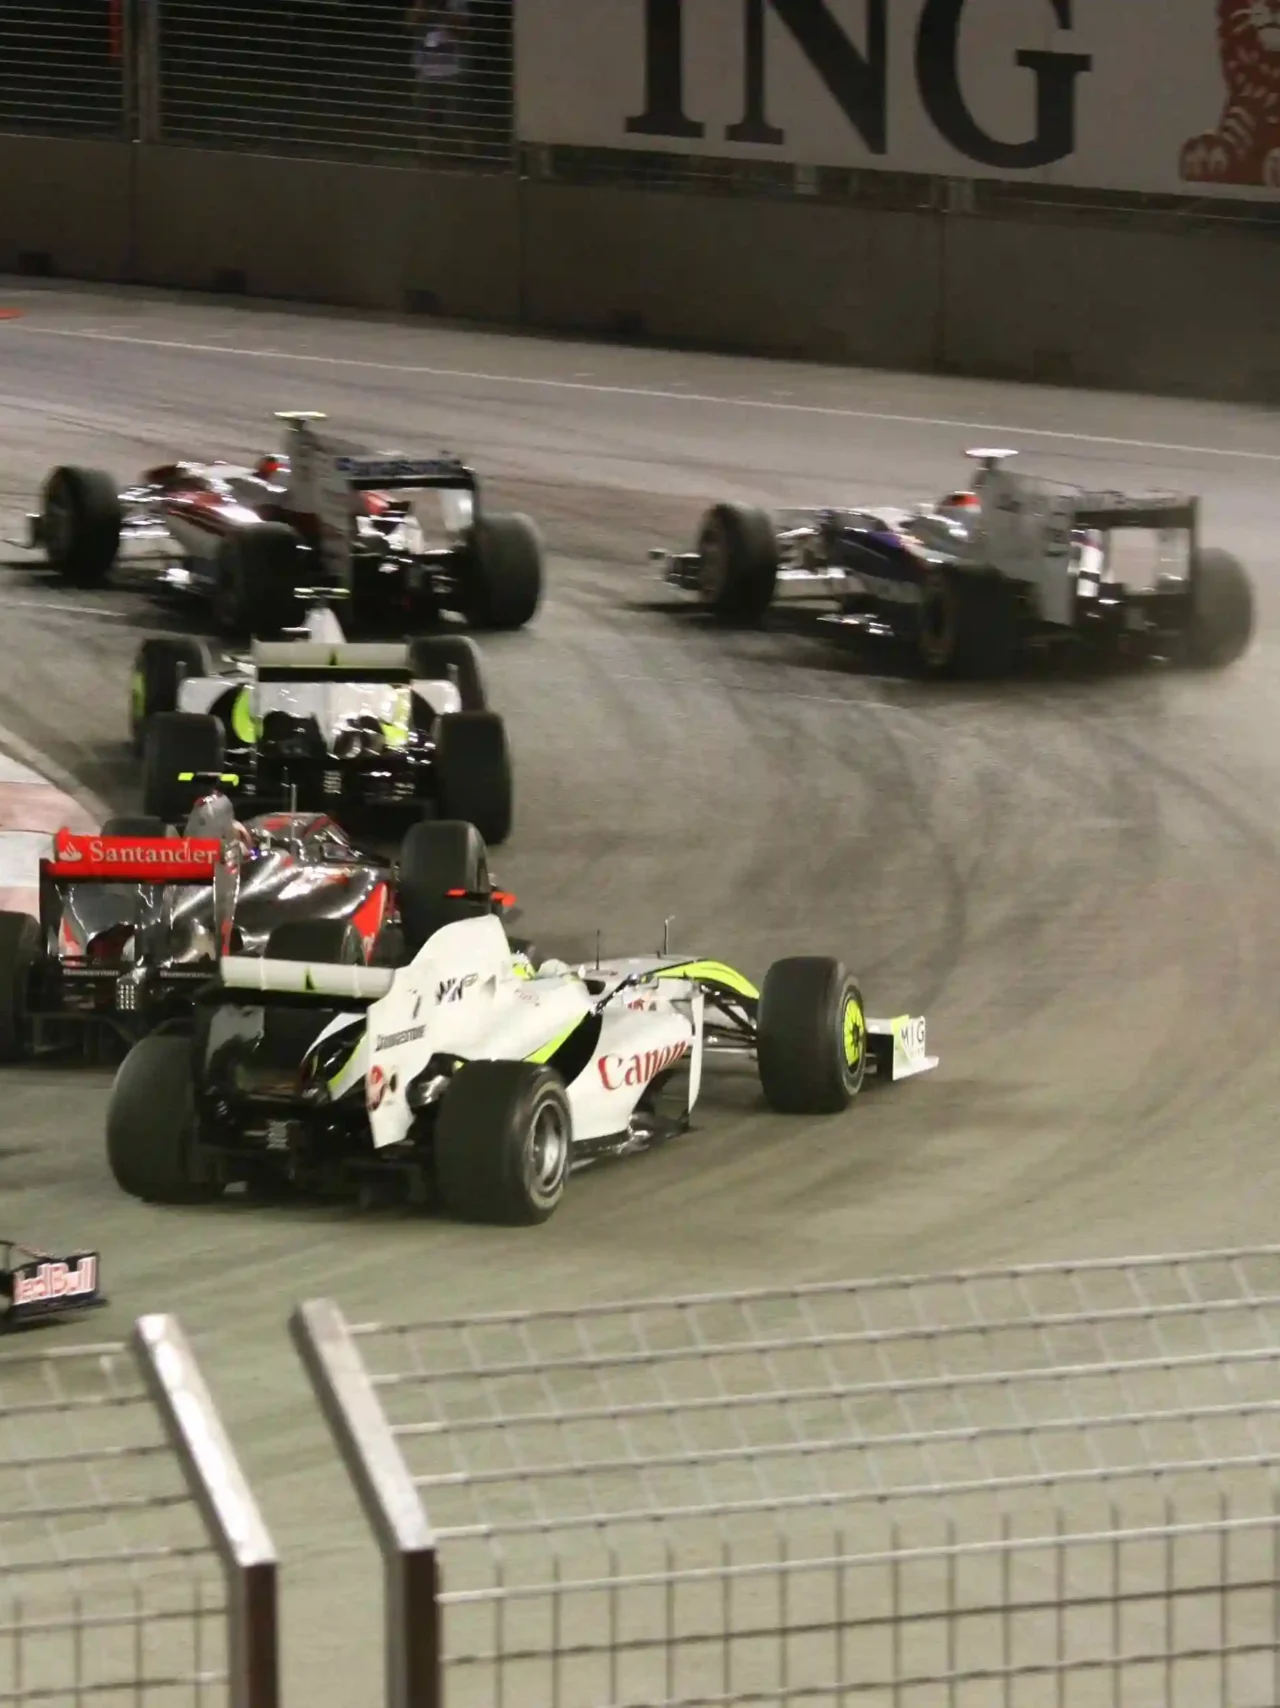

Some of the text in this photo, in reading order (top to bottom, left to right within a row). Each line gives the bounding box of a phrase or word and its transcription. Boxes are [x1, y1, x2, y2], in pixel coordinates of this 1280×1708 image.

[624, 0, 1092, 170] ING
[88, 837, 218, 865] Santander
[597, 1040, 689, 1092] Canon
